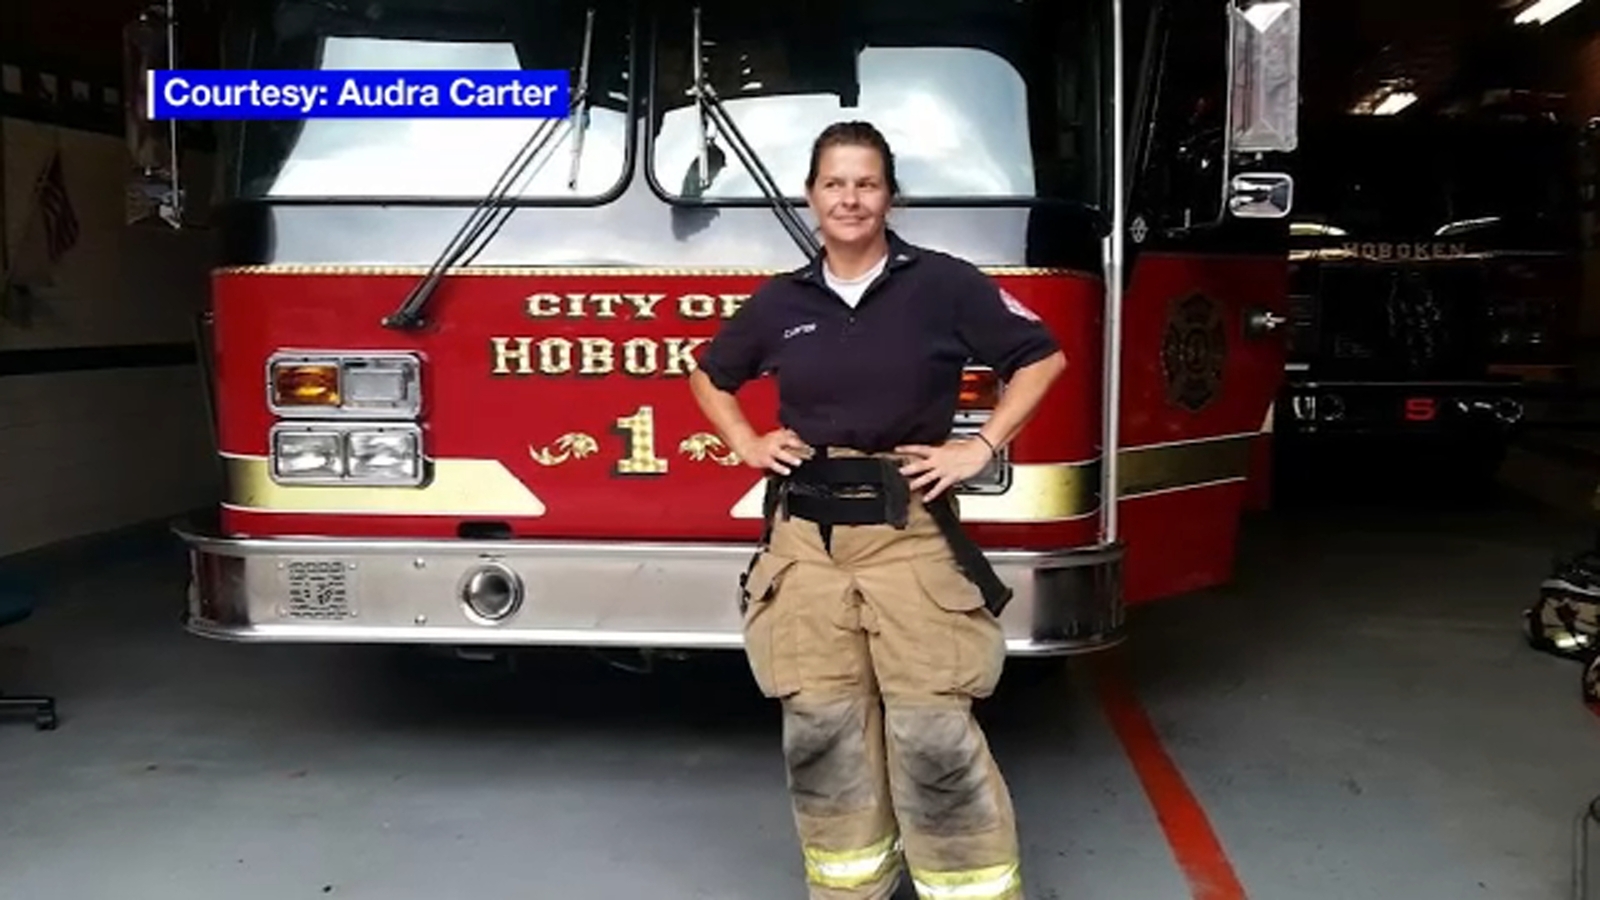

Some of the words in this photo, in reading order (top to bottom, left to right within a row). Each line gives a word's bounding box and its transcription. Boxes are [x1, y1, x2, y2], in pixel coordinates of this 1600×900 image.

[1342, 242, 1467, 258] HOBOKEN
[528, 294, 665, 317] CITY
[678, 294, 752, 318] OF
[491, 337, 713, 375] HOBOK
[617, 406, 669, 474] 1
